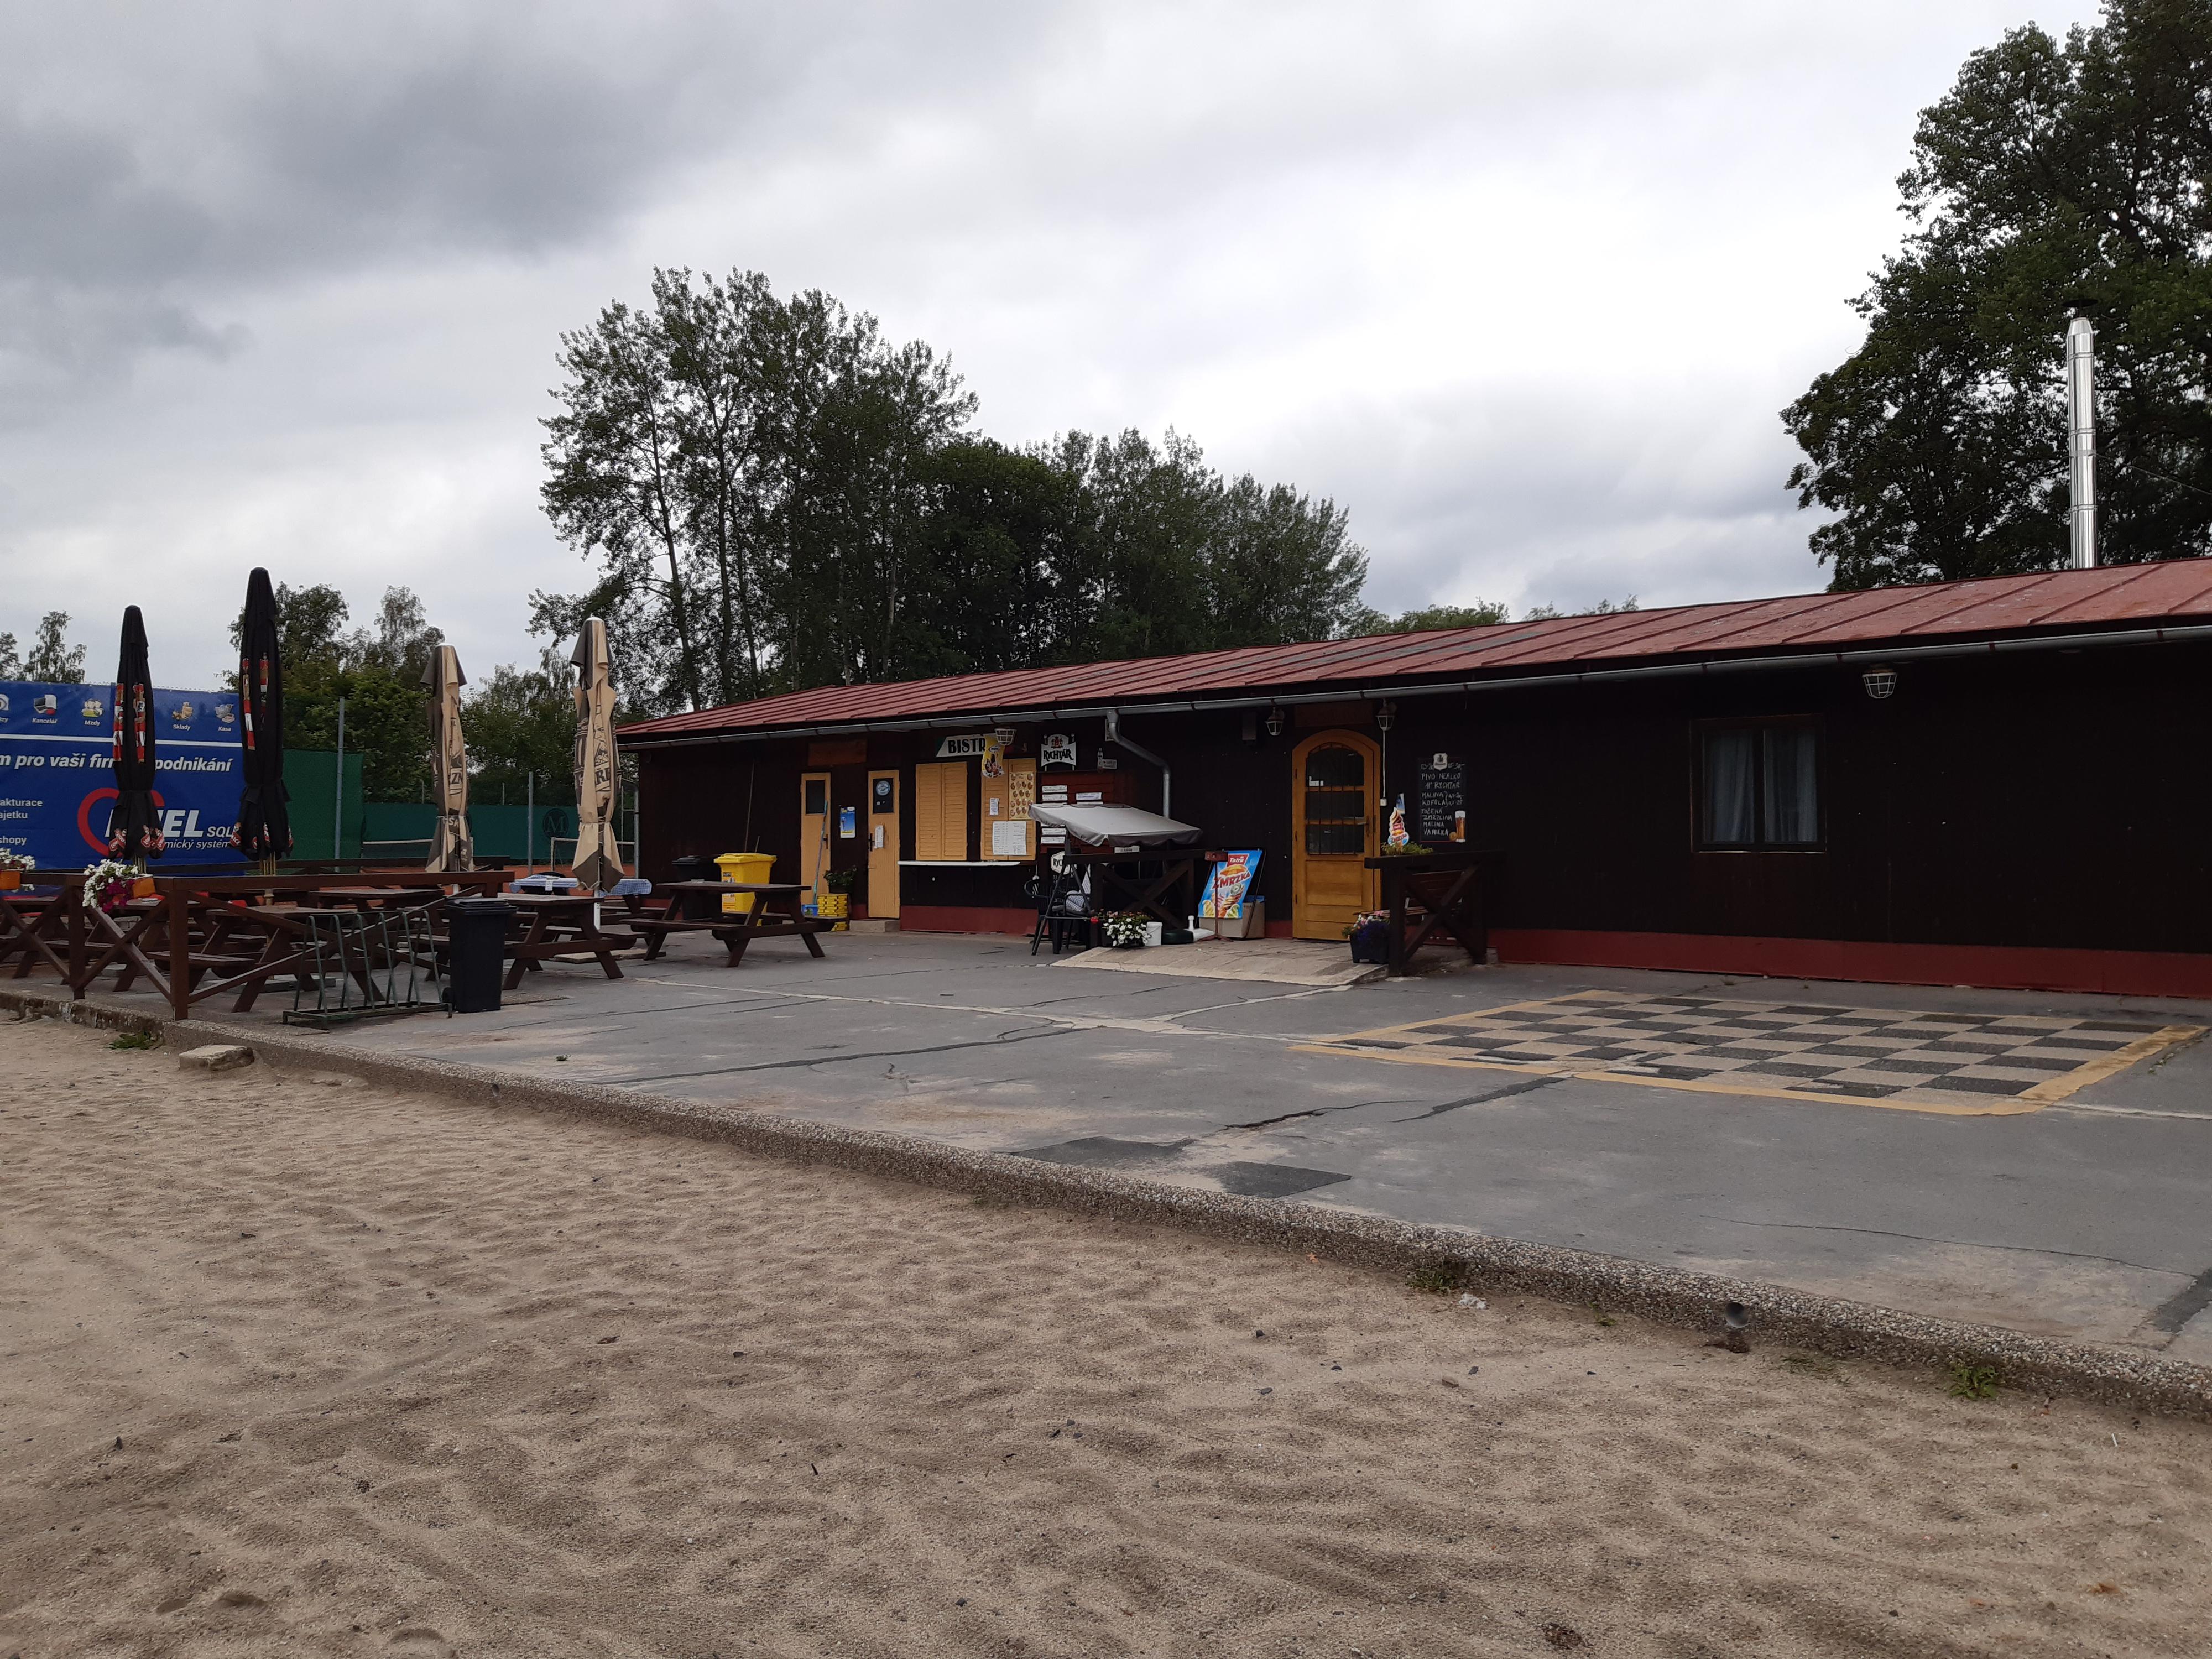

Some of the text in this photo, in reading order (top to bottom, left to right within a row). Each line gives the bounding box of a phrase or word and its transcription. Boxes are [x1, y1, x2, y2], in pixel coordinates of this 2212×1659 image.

[948, 738, 986, 754] BISTR
[1043, 748, 1074, 762] RYCHTÁŘ
[14, 755, 45, 770] pro
[50, 753, 86, 768] vaši
[155, 757, 233, 771] podnikání
[1434, 780, 1460, 789] RYCHTÁŘ
[0, 797, 43, 807] akturace
[0, 810, 28, 821] ajetku
[207, 826, 233, 838] SQL
[1424, 828, 1449, 836] VANILKA
[165, 839, 194, 851] mický
